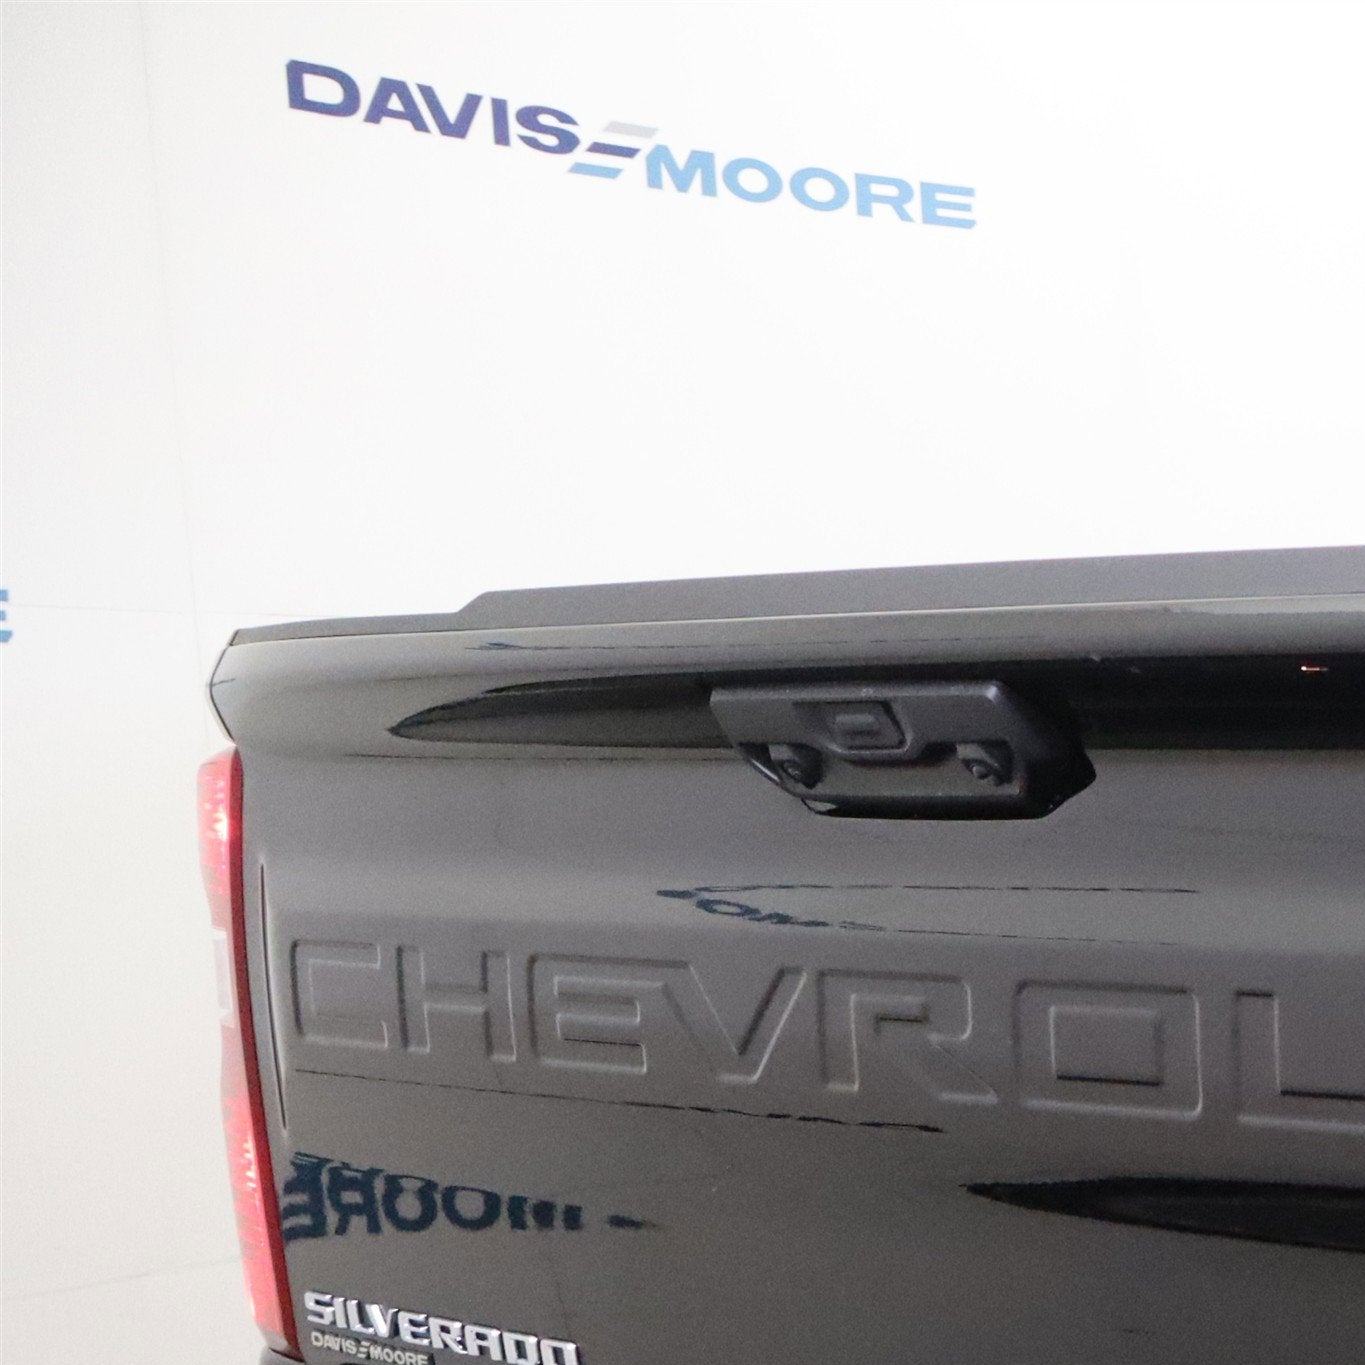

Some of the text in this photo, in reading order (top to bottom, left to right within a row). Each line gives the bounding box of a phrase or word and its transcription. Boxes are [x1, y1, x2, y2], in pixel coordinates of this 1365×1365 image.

[286, 59, 977, 230] DAVIS MOORE
[310, 1331, 358, 1355] DAVIS
